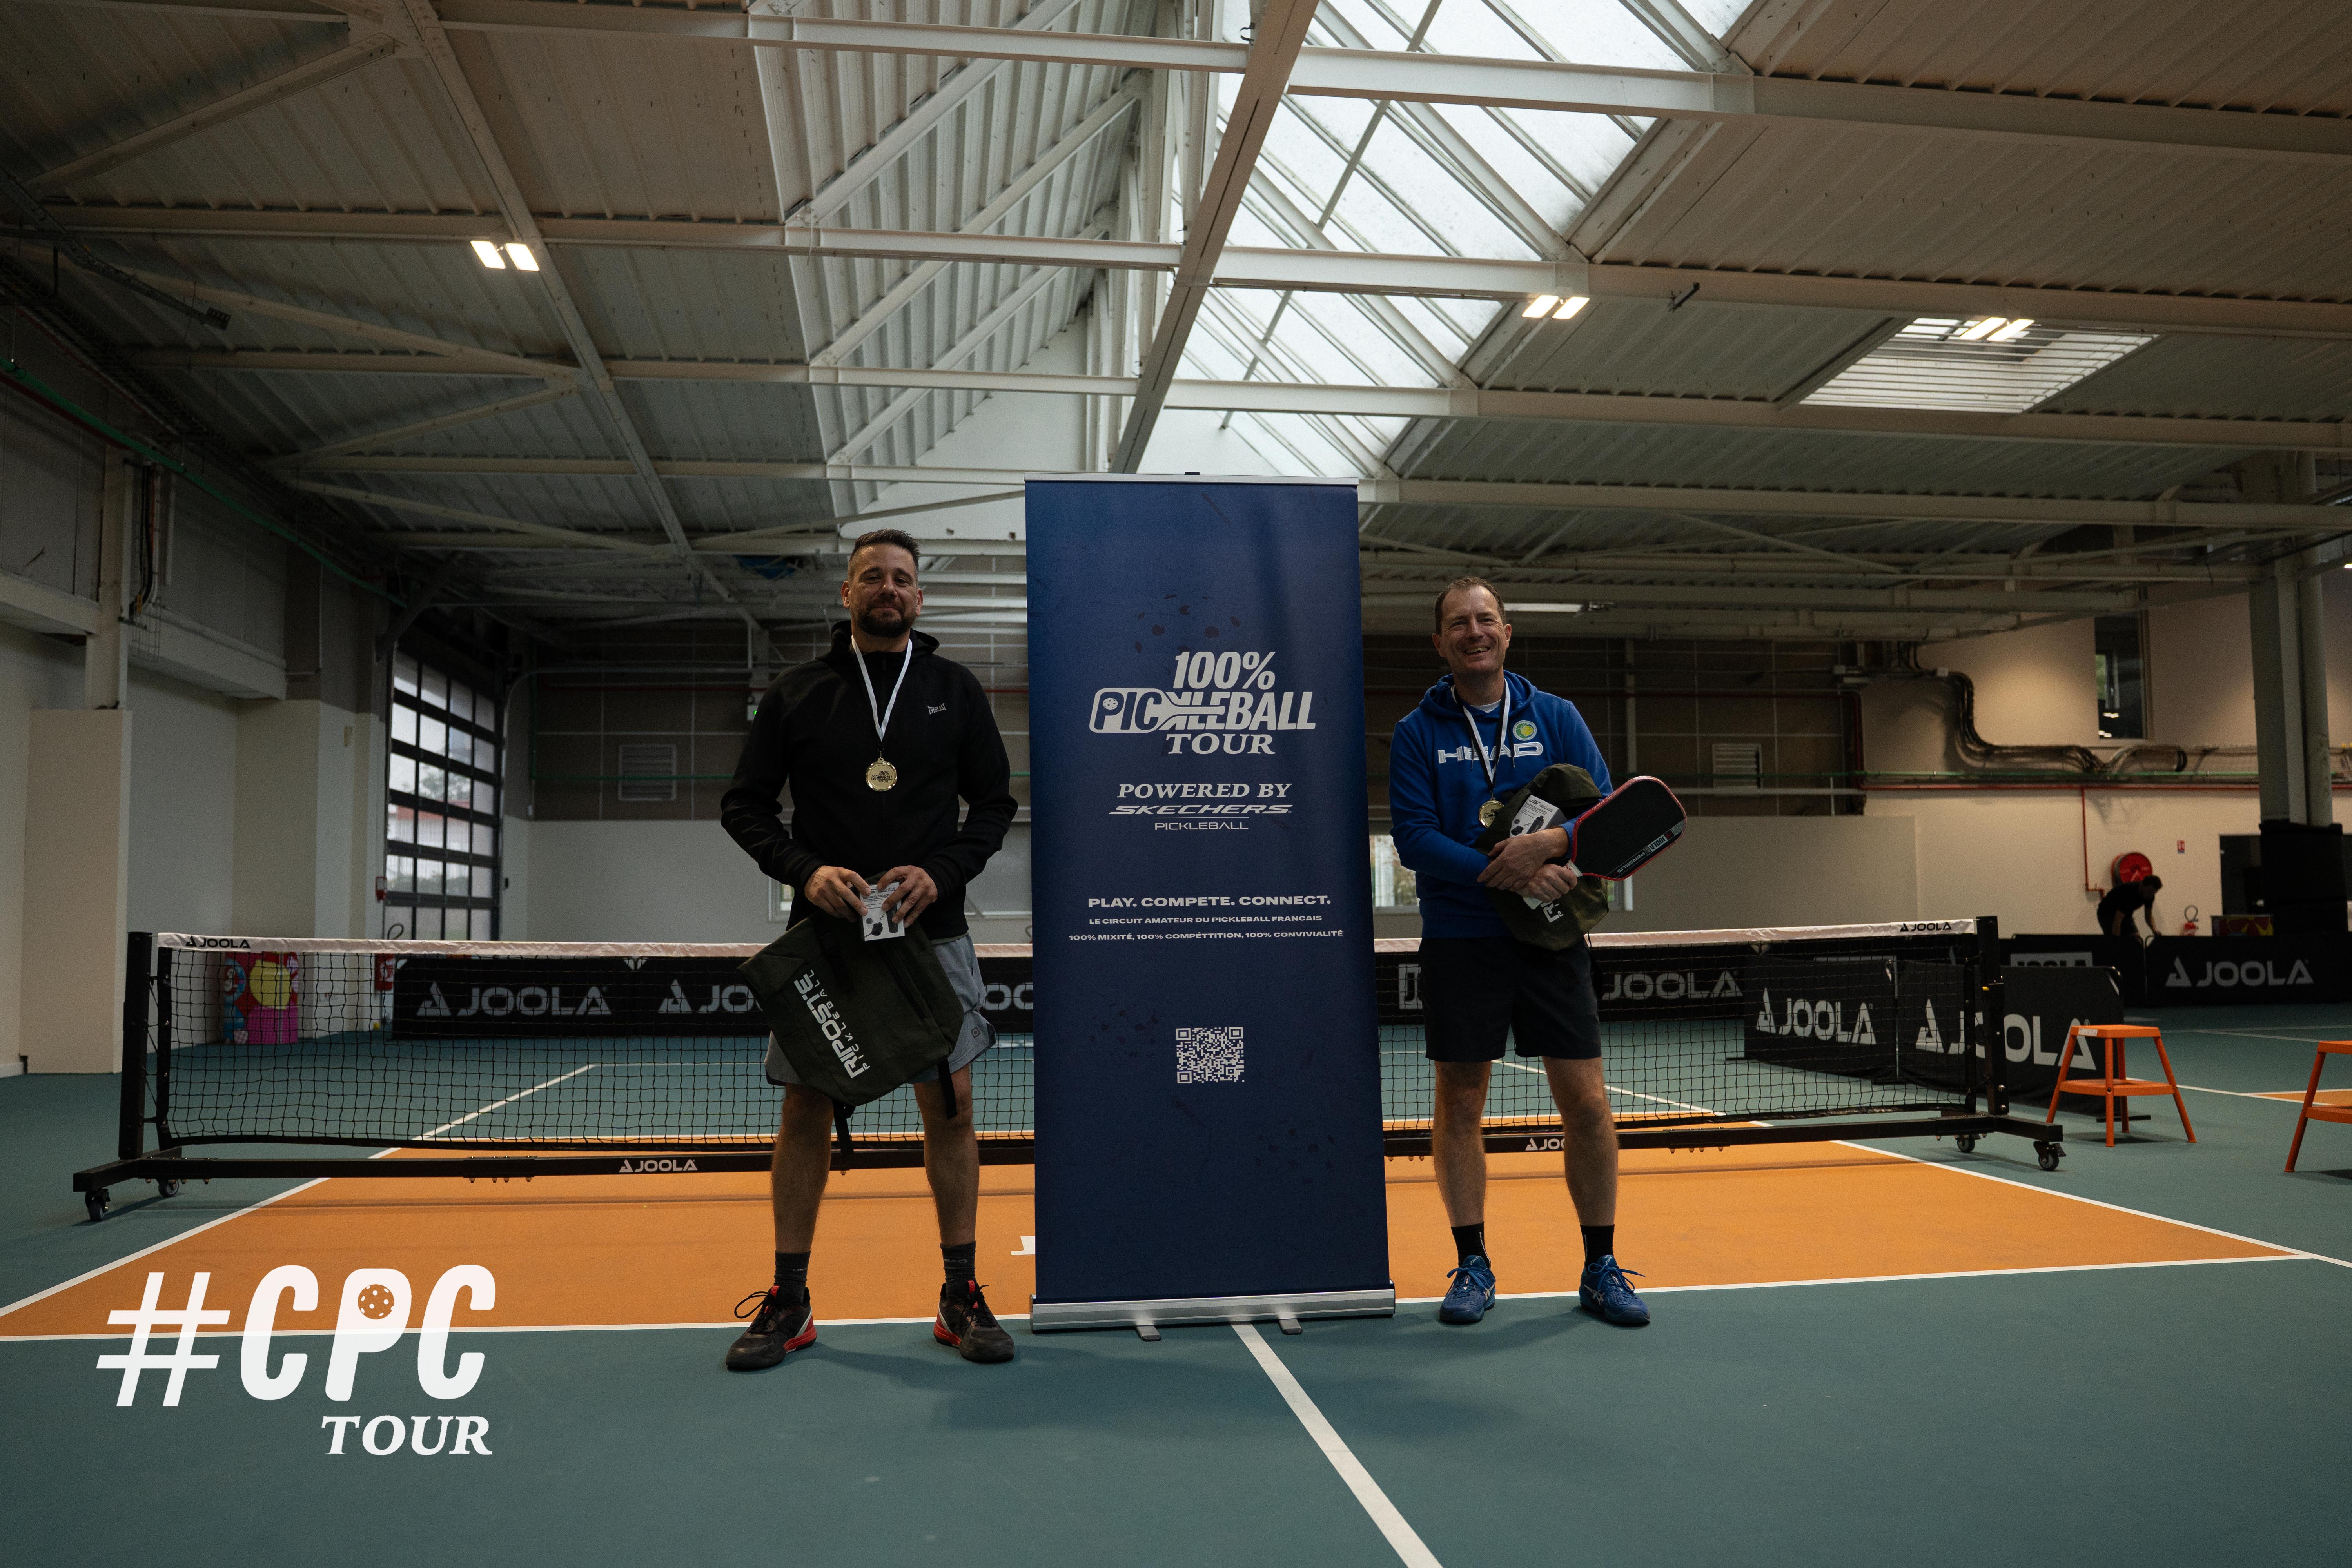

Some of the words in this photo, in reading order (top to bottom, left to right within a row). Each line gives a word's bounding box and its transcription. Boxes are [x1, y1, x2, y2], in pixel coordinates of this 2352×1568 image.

[1173, 651, 1276, 690] 100%
[927, 703, 946, 715] EVERLAST
[1089, 688, 1316, 733] PICKLEBALL
[1166, 733, 1275, 755] TOUR
[1437, 742, 1543, 764] HEAD
[1117, 783, 1250, 799] POWERED
[1257, 783, 1292, 797] BY
[1109, 804, 1293, 815] SKECHERS
[1154, 822, 1249, 830] PICKLEBALL
[1649, 836, 1666, 849] JOOLA
[1617, 851, 1646, 873] PERSEUS
[1088, 898, 1137, 907] PLAY.
[1141, 897, 1235, 907] COMPETE.
[1239, 895, 1331, 906] CONNECT.
[1273, 929, 1343, 938] CONVIVIALITÉ
[1911, 921, 1952, 932] JOOLA
[199, 938, 250, 949] JOOLA
[2196, 959, 2314, 987] JOOLA
[1602, 970, 1743, 1000] JOOLA
[457, 986, 612, 1016] JOOLA
[794, 974, 864, 1078] RIPOSTE
[809, 969, 871, 1070] PICKLEBALL
[1779, 997, 1877, 1045] JOOLA
[634, 1159, 698, 1172] JOOLA
